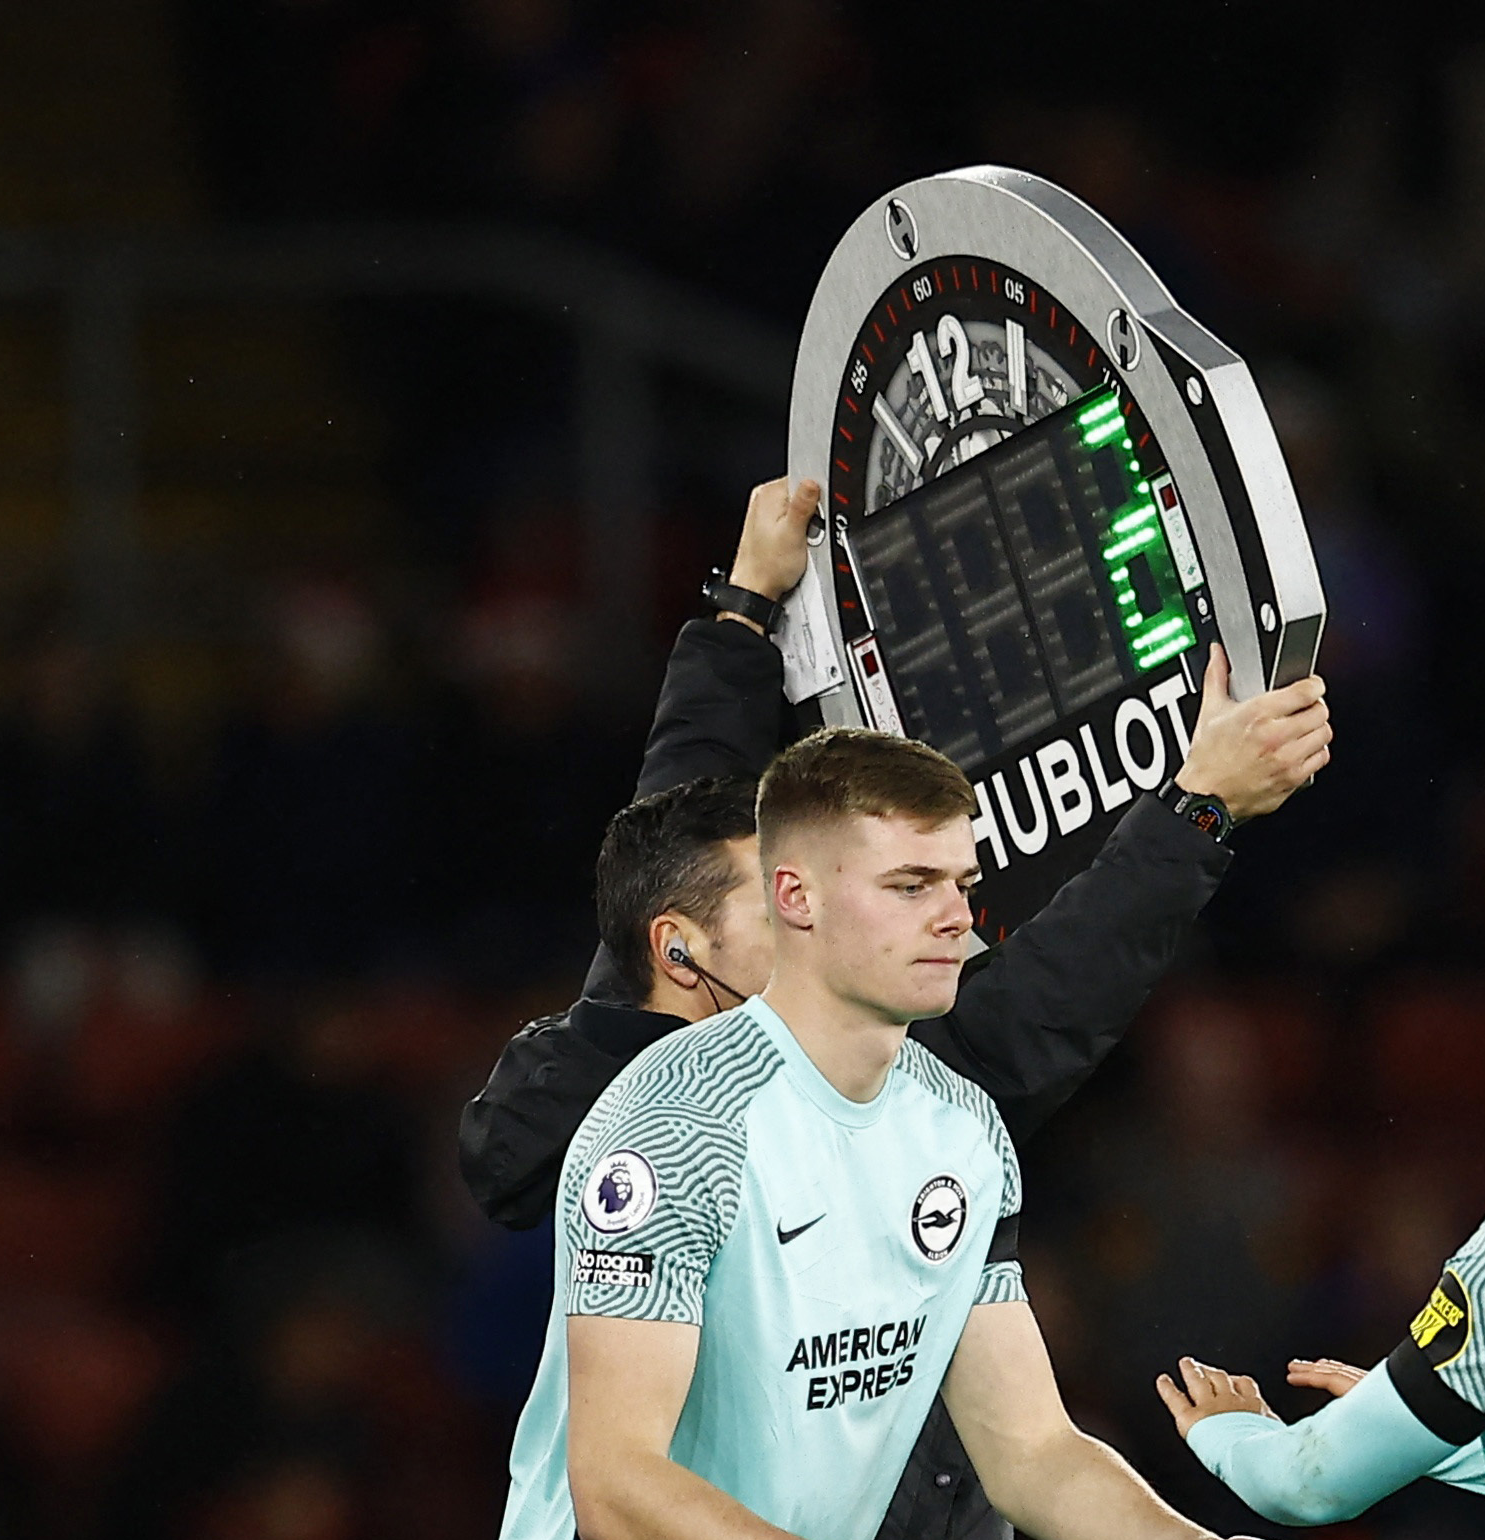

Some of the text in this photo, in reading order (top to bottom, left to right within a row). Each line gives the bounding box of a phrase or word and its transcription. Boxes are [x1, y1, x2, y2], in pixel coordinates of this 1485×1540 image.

[912, 275, 932, 302] 60
[1005, 278, 1025, 305] 05
[851, 358, 868, 394] 55
[906, 314, 985, 422] 12
[575, 1250, 643, 1272] No room
[593, 1269, 651, 1287] racism
[785, 1314, 927, 1372] AMERICAN
[806, 1352, 917, 1411] EXPRESS
